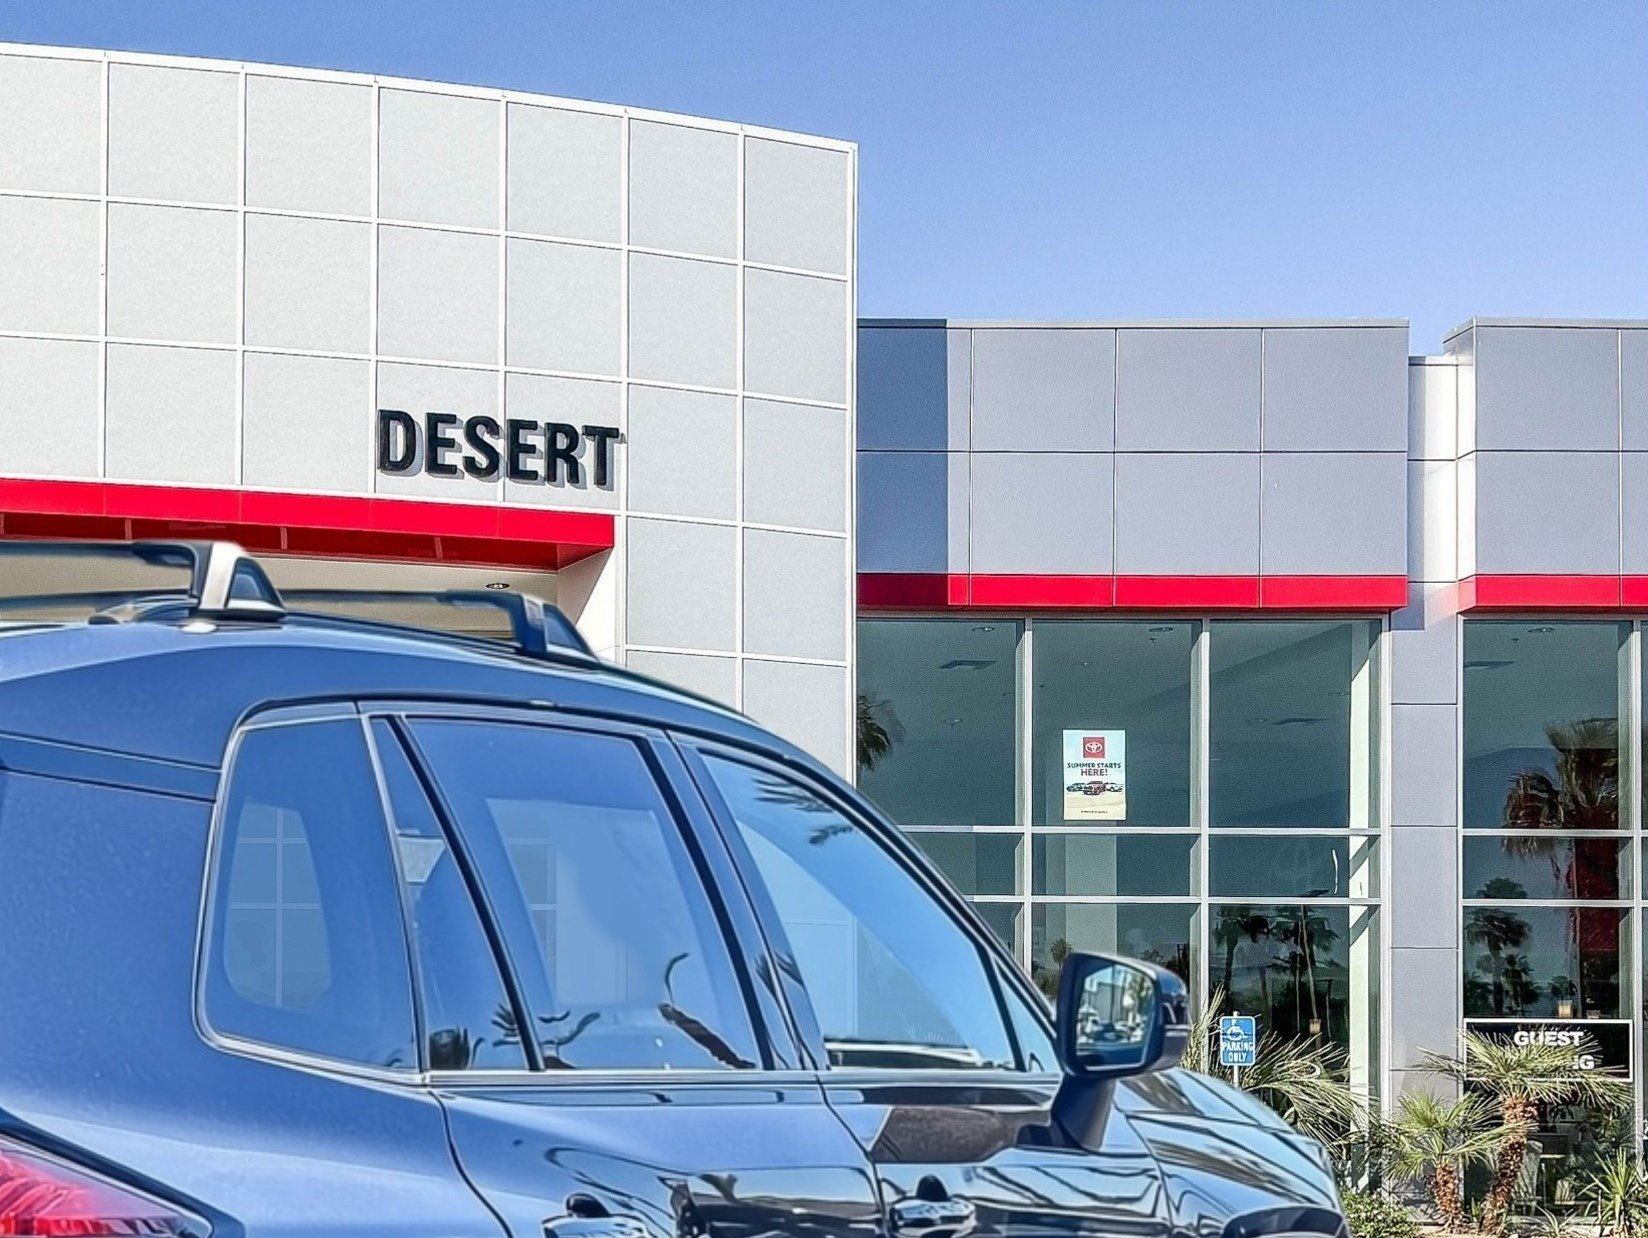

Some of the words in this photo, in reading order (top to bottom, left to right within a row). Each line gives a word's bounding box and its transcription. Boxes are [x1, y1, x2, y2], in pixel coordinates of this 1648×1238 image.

[377, 409, 621, 487] DESERT
[1081, 768, 1108, 776] HERE!
[1513, 1030, 1584, 1047] GUEST
[1222, 1041, 1254, 1052] PARKING
[1228, 1051, 1247, 1062] ONLY
